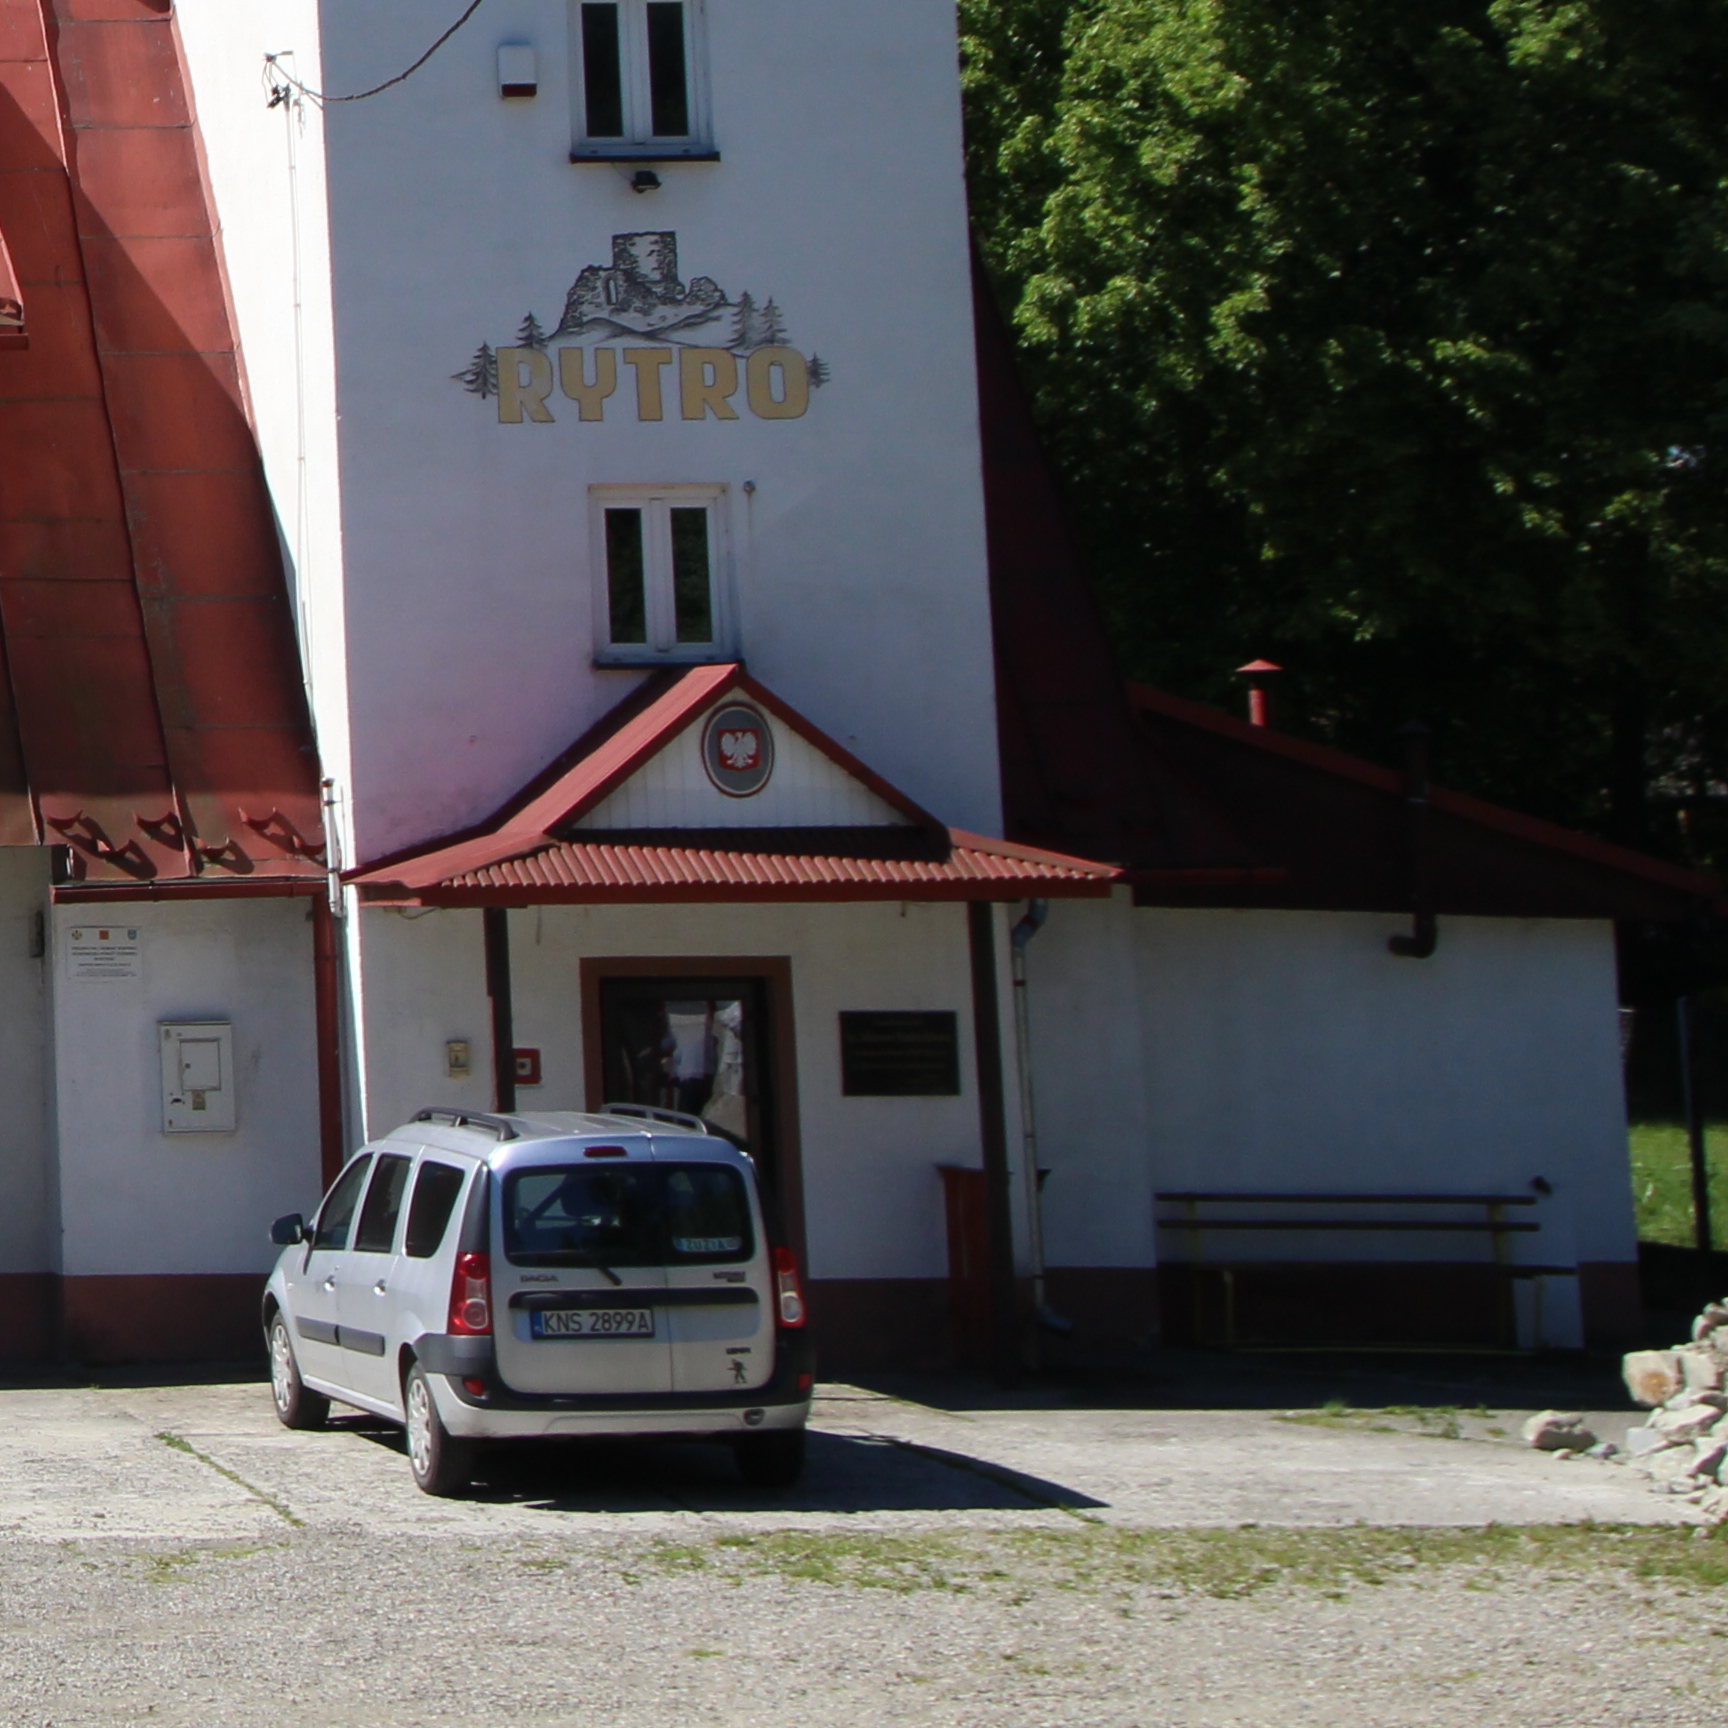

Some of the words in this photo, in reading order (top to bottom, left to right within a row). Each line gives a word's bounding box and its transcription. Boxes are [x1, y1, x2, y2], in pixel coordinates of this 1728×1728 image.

[495, 346, 809, 423] RYTRO
[544, 1312, 582, 1333] KNS
[589, 1311, 649, 1332] 2899A
